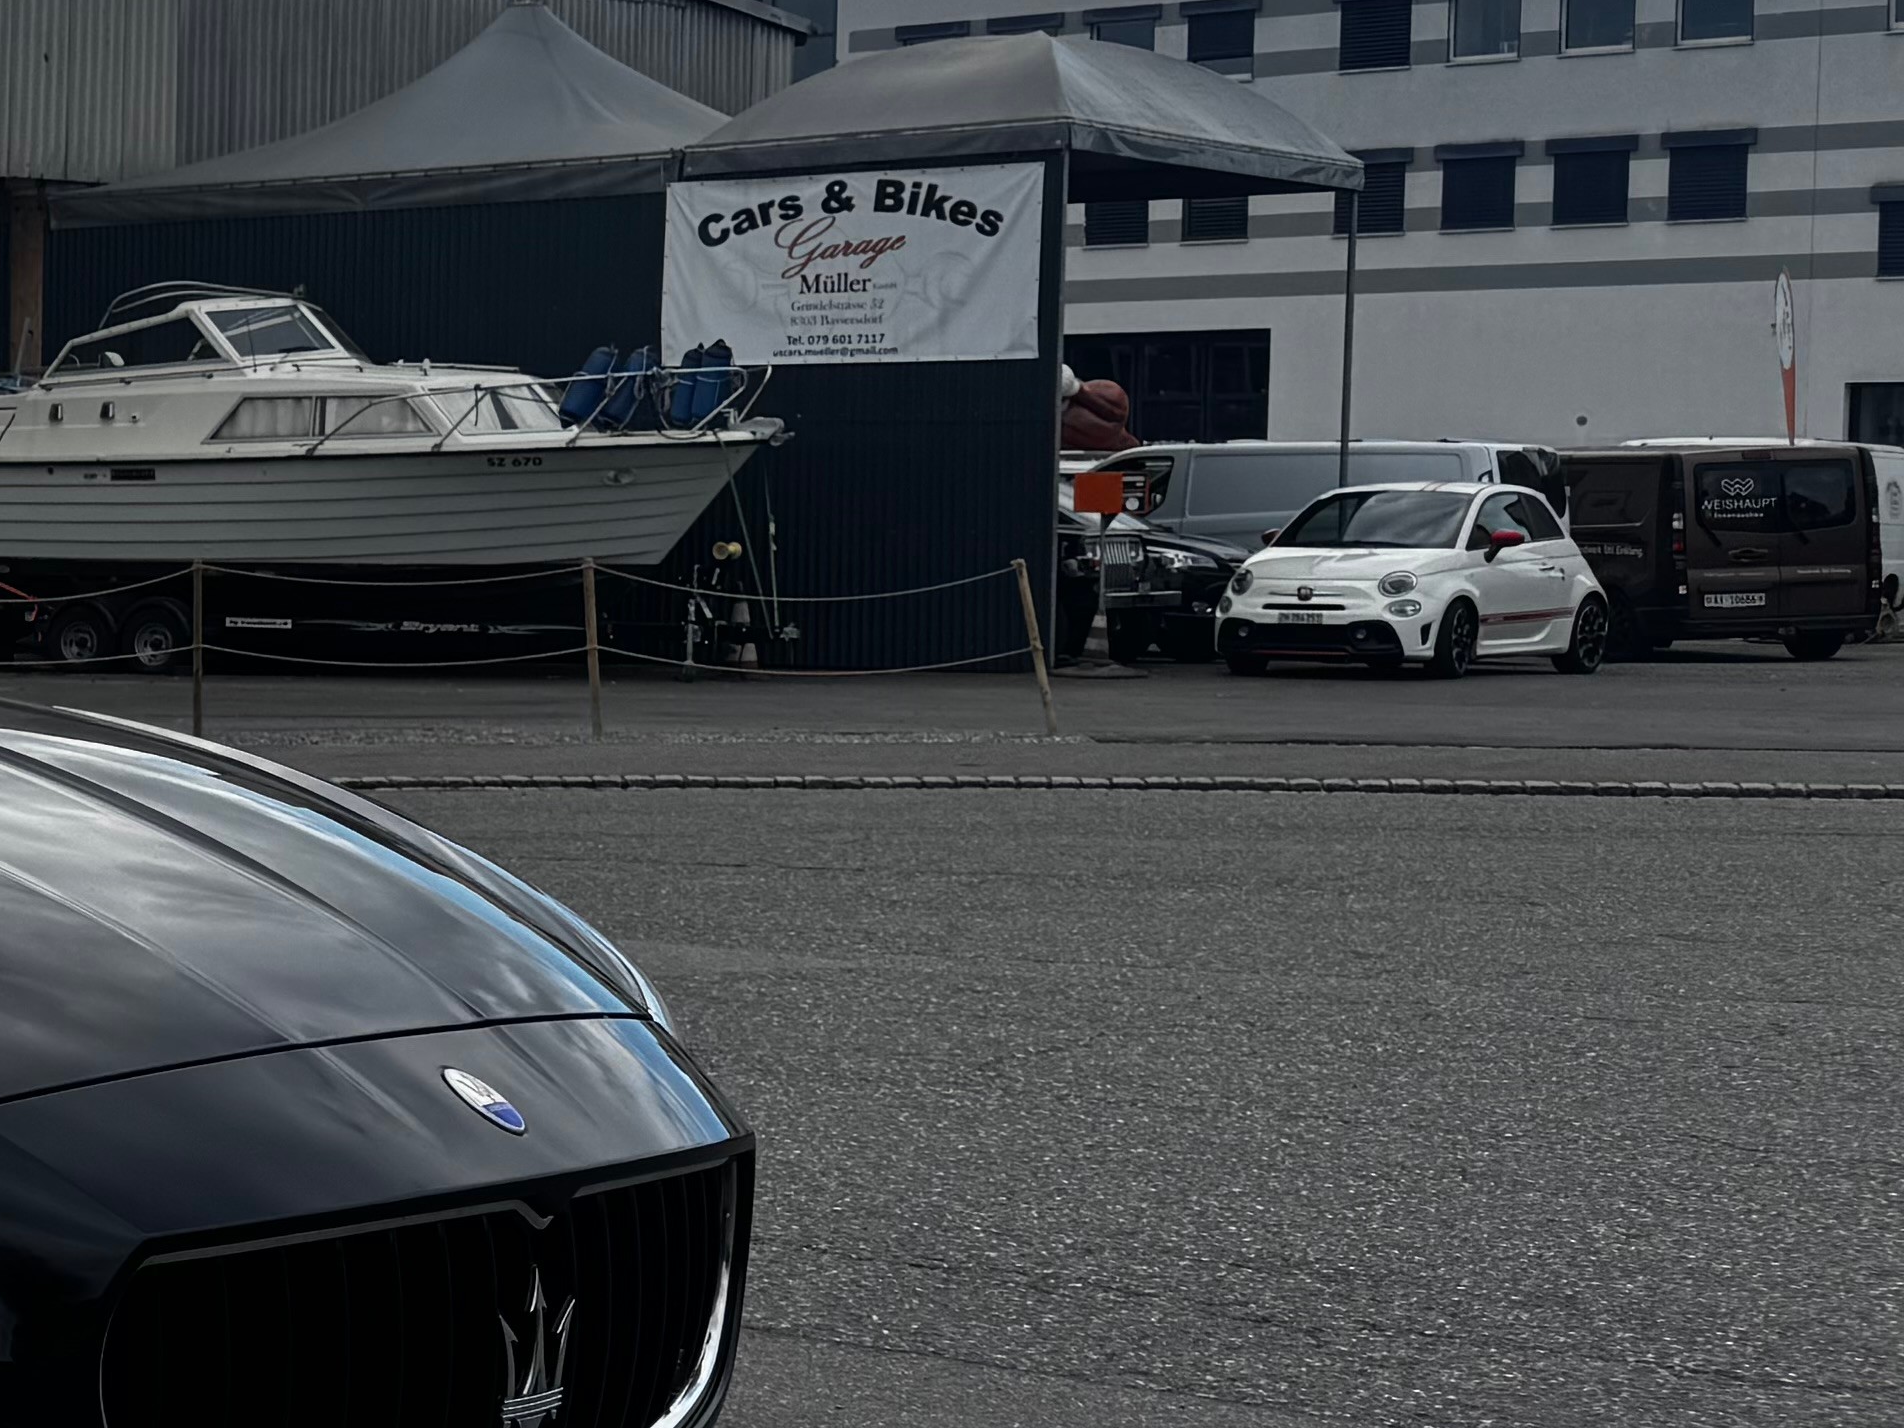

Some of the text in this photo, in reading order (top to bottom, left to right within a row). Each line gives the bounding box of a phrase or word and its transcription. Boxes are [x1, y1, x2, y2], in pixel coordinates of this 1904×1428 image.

[697, 178, 1005, 248] Cars & Bikes
[774, 215, 907, 280] Garage
[799, 272, 872, 294] Müller
[786, 333, 885, 346] Tel. 079 601 7117
[1701, 497, 1777, 510] WEISHAUPT
